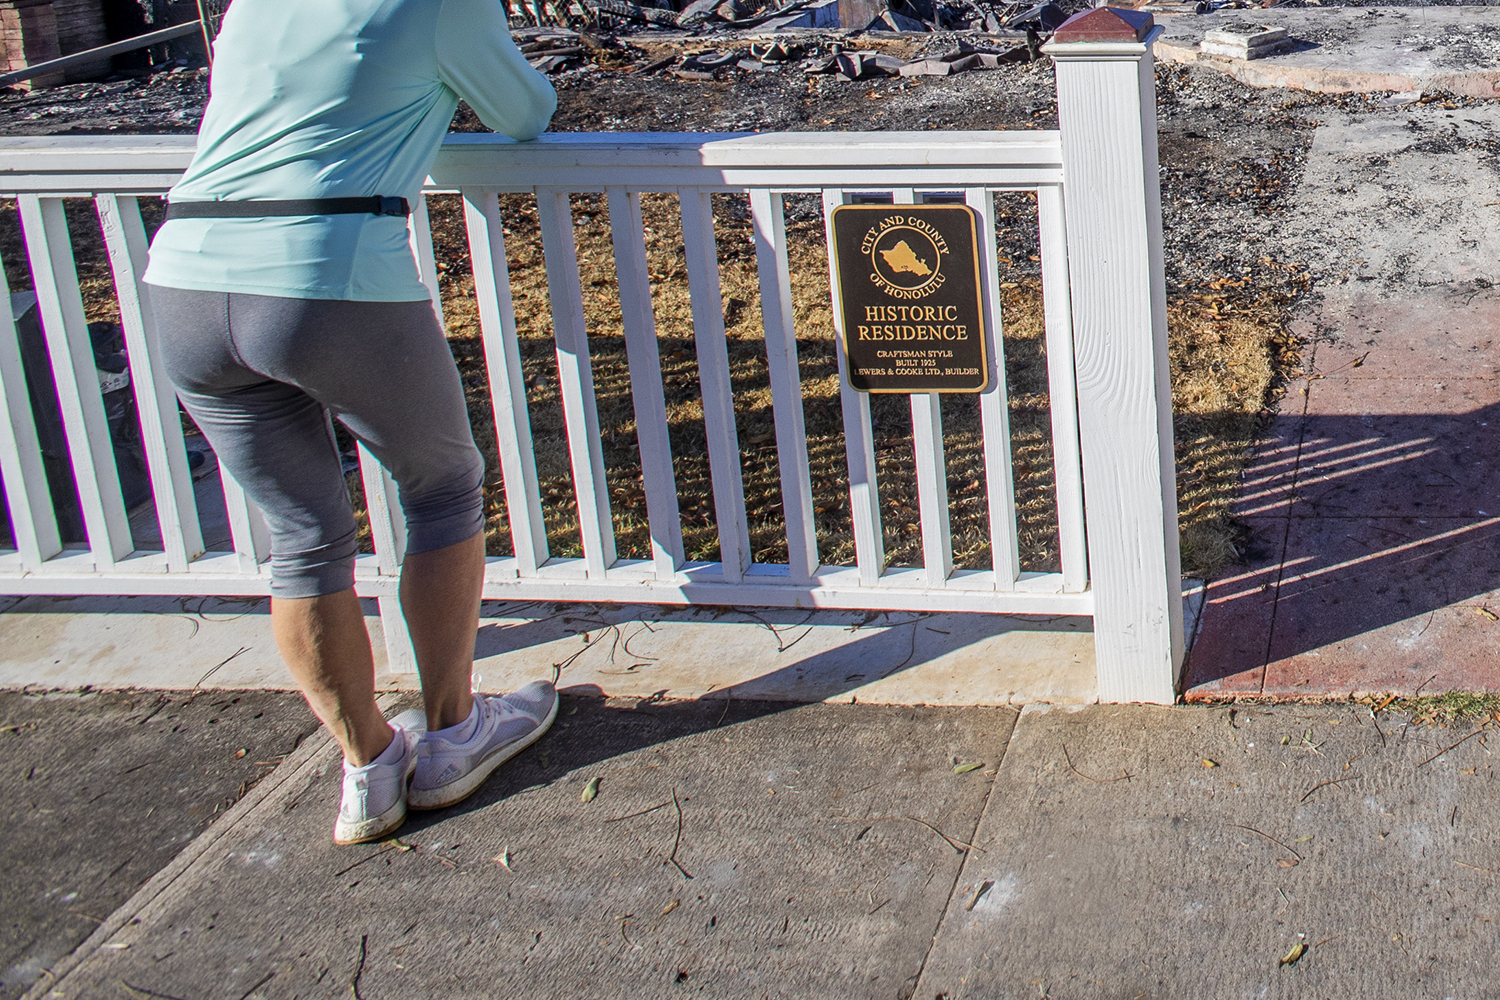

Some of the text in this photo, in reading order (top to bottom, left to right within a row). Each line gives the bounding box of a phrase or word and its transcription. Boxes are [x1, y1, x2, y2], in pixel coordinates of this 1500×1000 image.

[861, 215, 950, 255] CITY AND COUNTY
[869, 272, 946, 300] OF HONOLULU
[864, 305, 958, 322] HISTORIC
[857, 325, 968, 341] RESIDENCE
[876, 350, 954, 358] CRAFTSMAN STYLE
[895, 359, 937, 367] BUILT 1925
[854, 368, 980, 377] LEWERS & COOKE LTD., BUILDER
